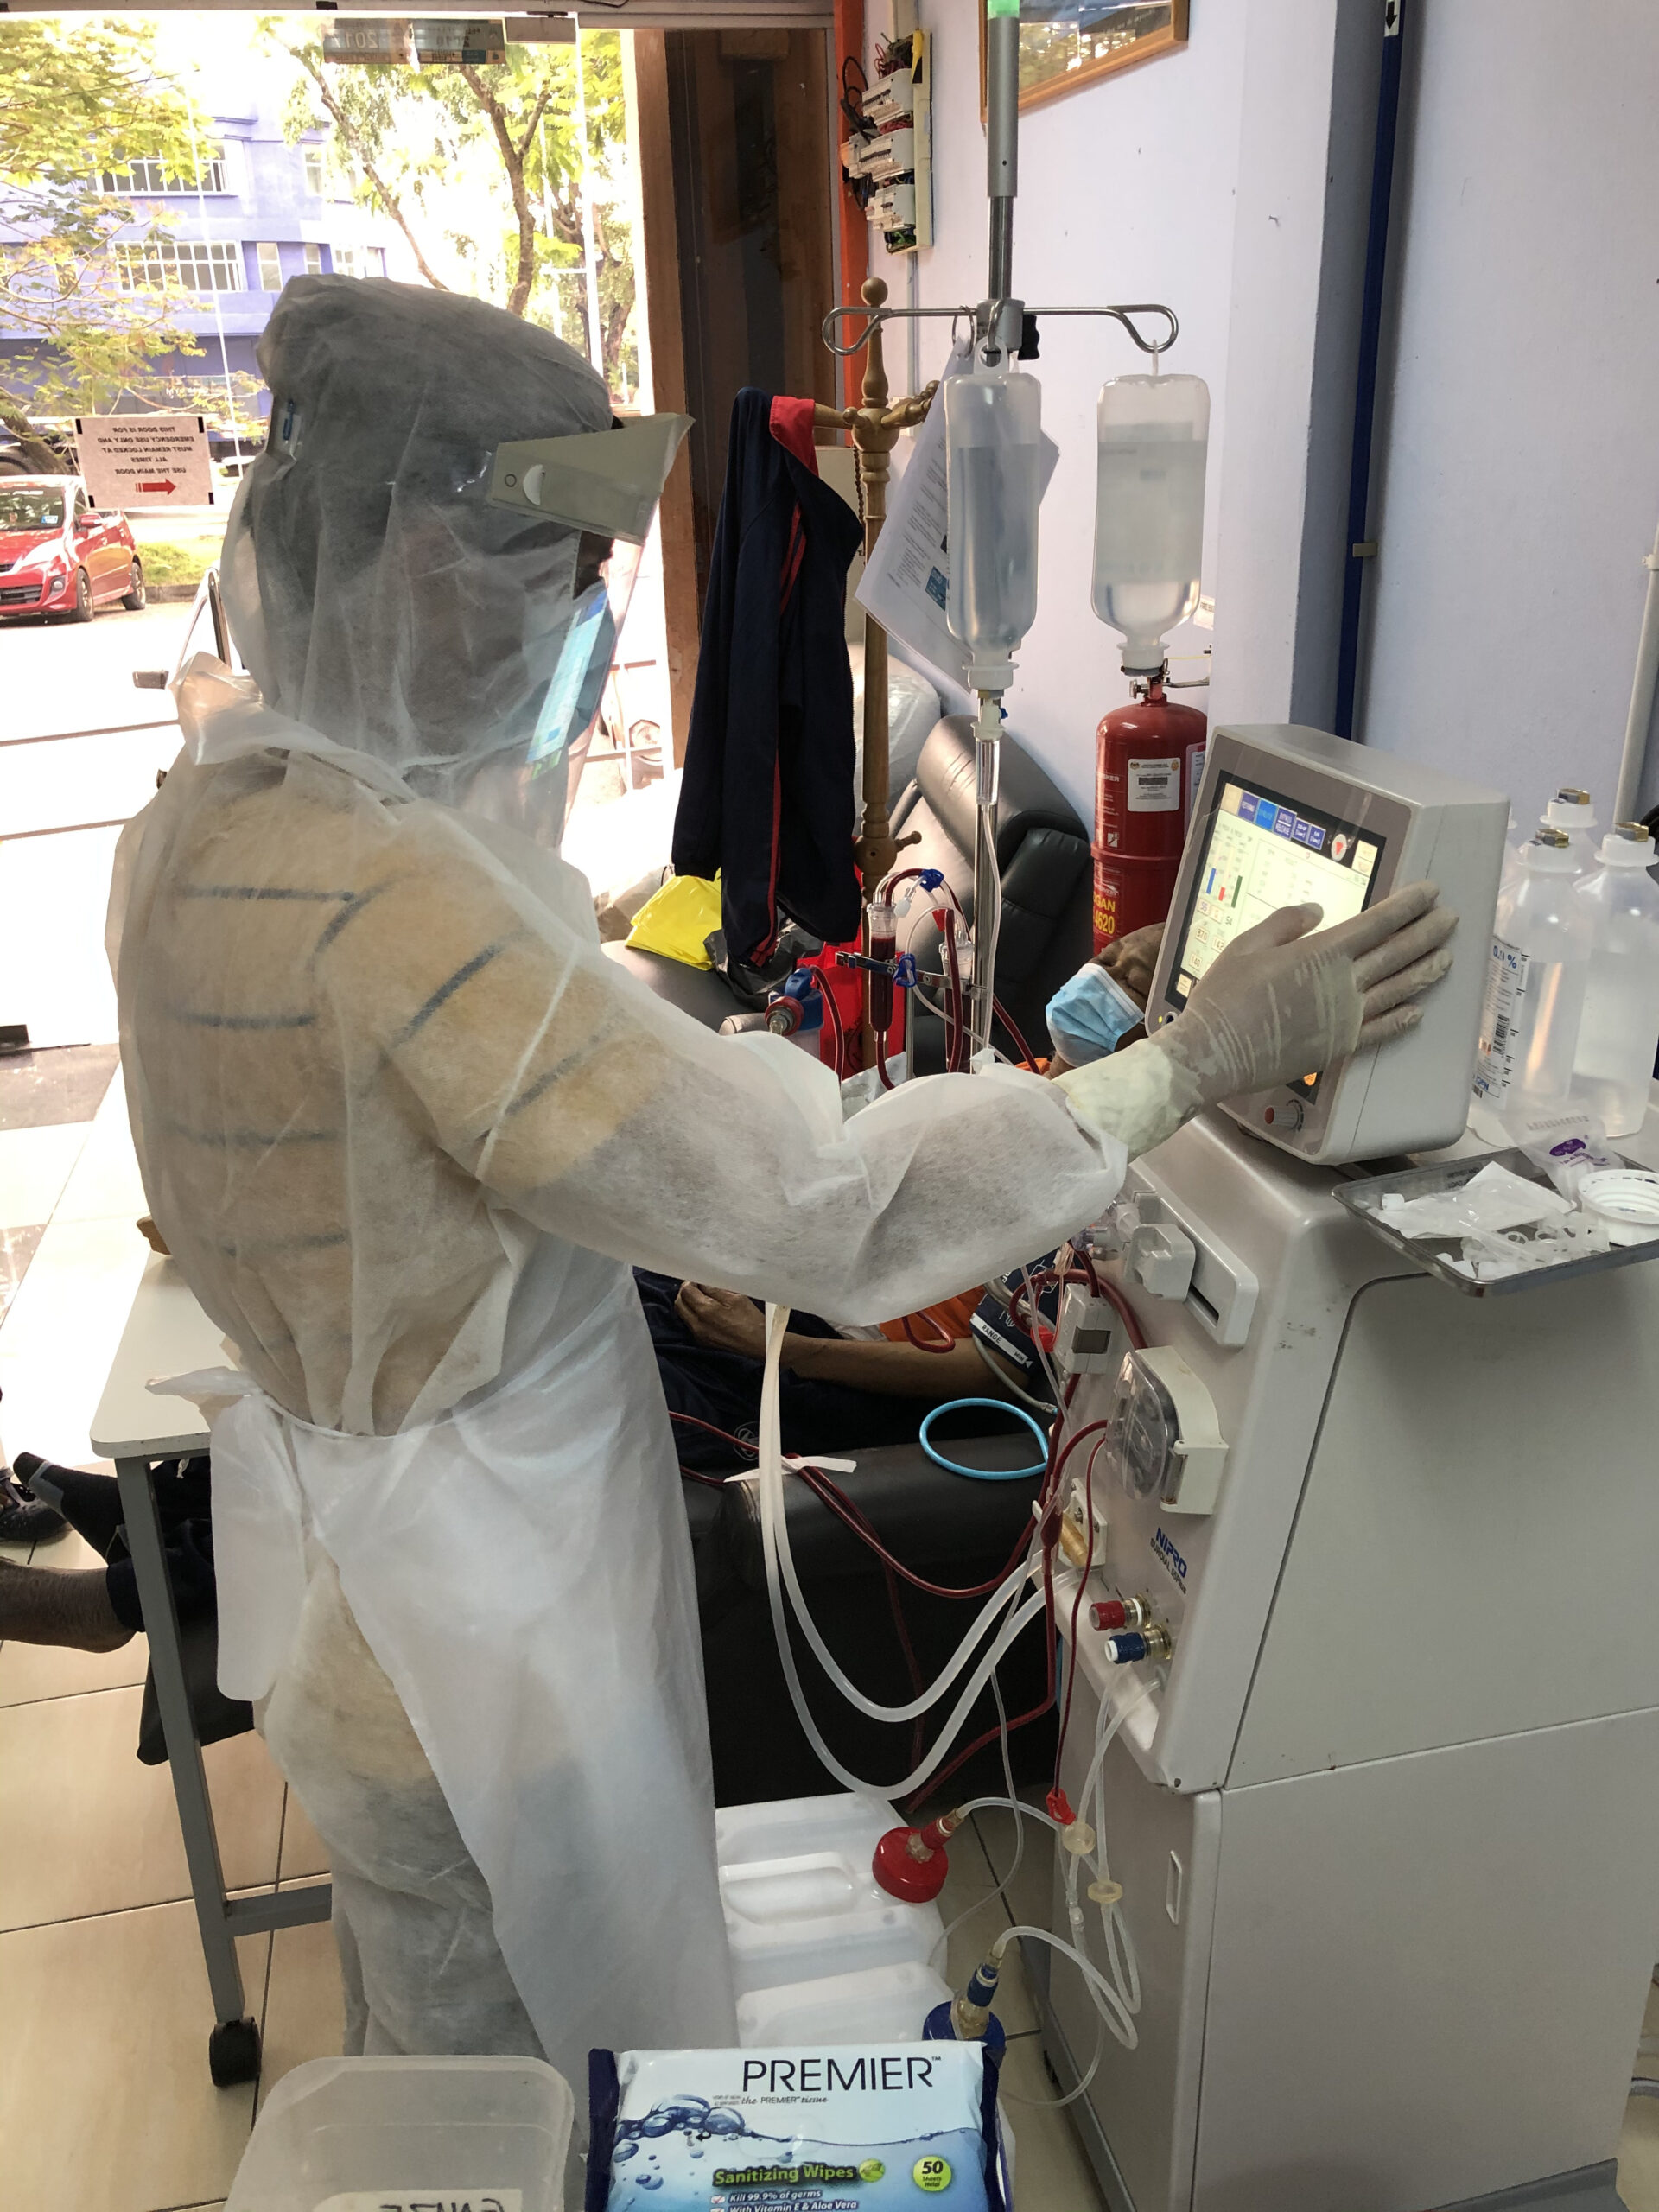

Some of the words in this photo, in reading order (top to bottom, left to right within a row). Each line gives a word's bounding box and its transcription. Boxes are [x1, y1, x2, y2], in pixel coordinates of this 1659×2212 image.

[982, 1324, 1002, 1344] RANGE
[1014, 1351, 1025, 1361] MIN
[1156, 1527, 1187, 1578] NIPRO
[741, 2096, 757, 2105] the
[922, 2160, 944, 2174] 50
[715, 2168, 799, 2184] Sanitizing
[803, 2164, 854, 2181] Wipes
[729, 2193, 746, 2203] Kill
[747, 2191, 778, 2200] 99.9%
[791, 2190, 821, 2202] germs
[753, 2203, 792, 2212] Vitamin
[811, 2202, 833, 2210] Aloe
[835, 2201, 857, 2209] Vera
